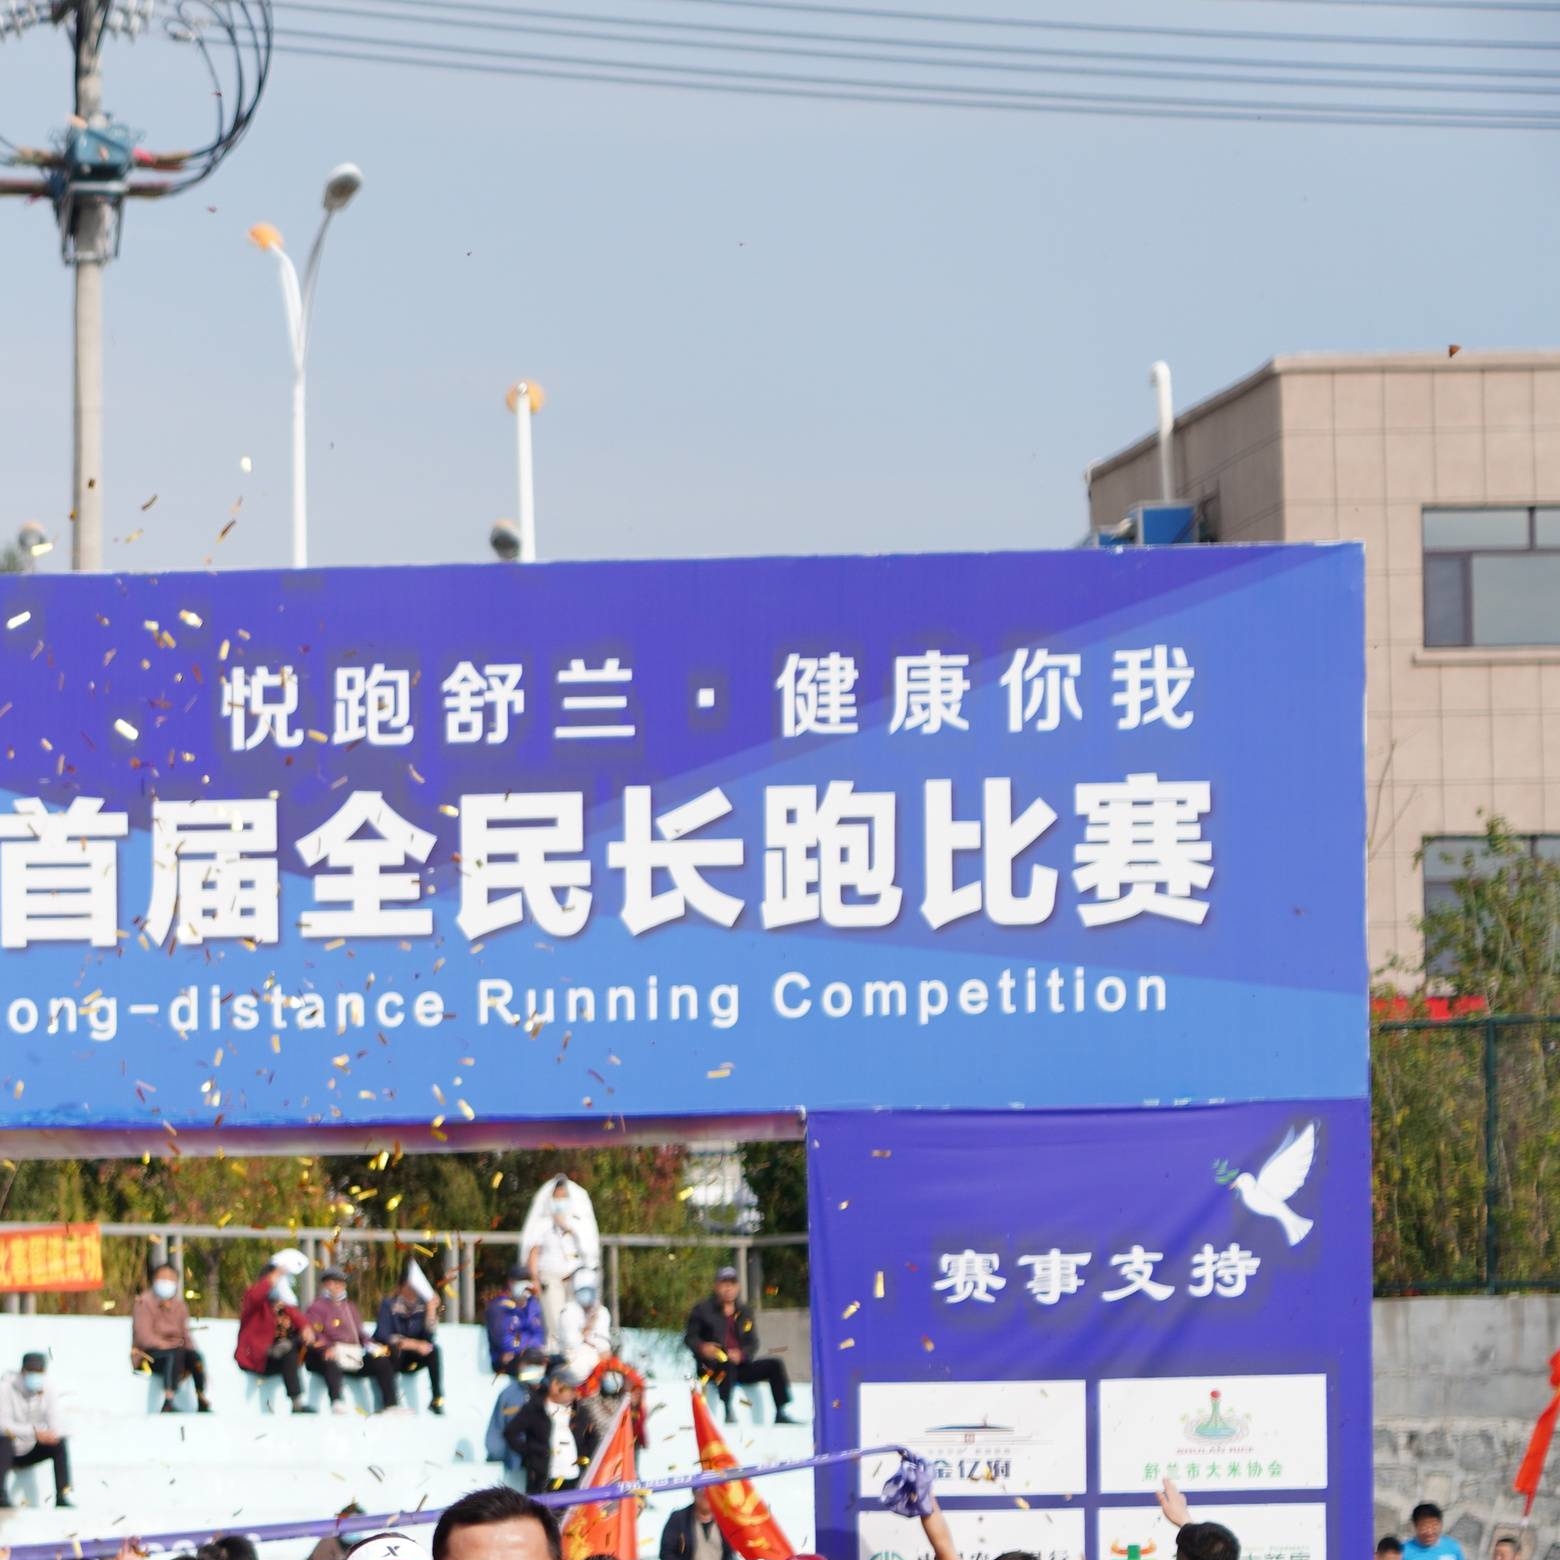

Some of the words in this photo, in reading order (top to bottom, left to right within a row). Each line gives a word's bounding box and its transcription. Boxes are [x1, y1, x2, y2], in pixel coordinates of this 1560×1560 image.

[477, 976, 740, 1028] Running
[773, 966, 1168, 1025] Competition
[933, 1243, 1261, 1305] 赛事支持
[1143, 1460, 1283, 1481] 舒兰市大米协会
